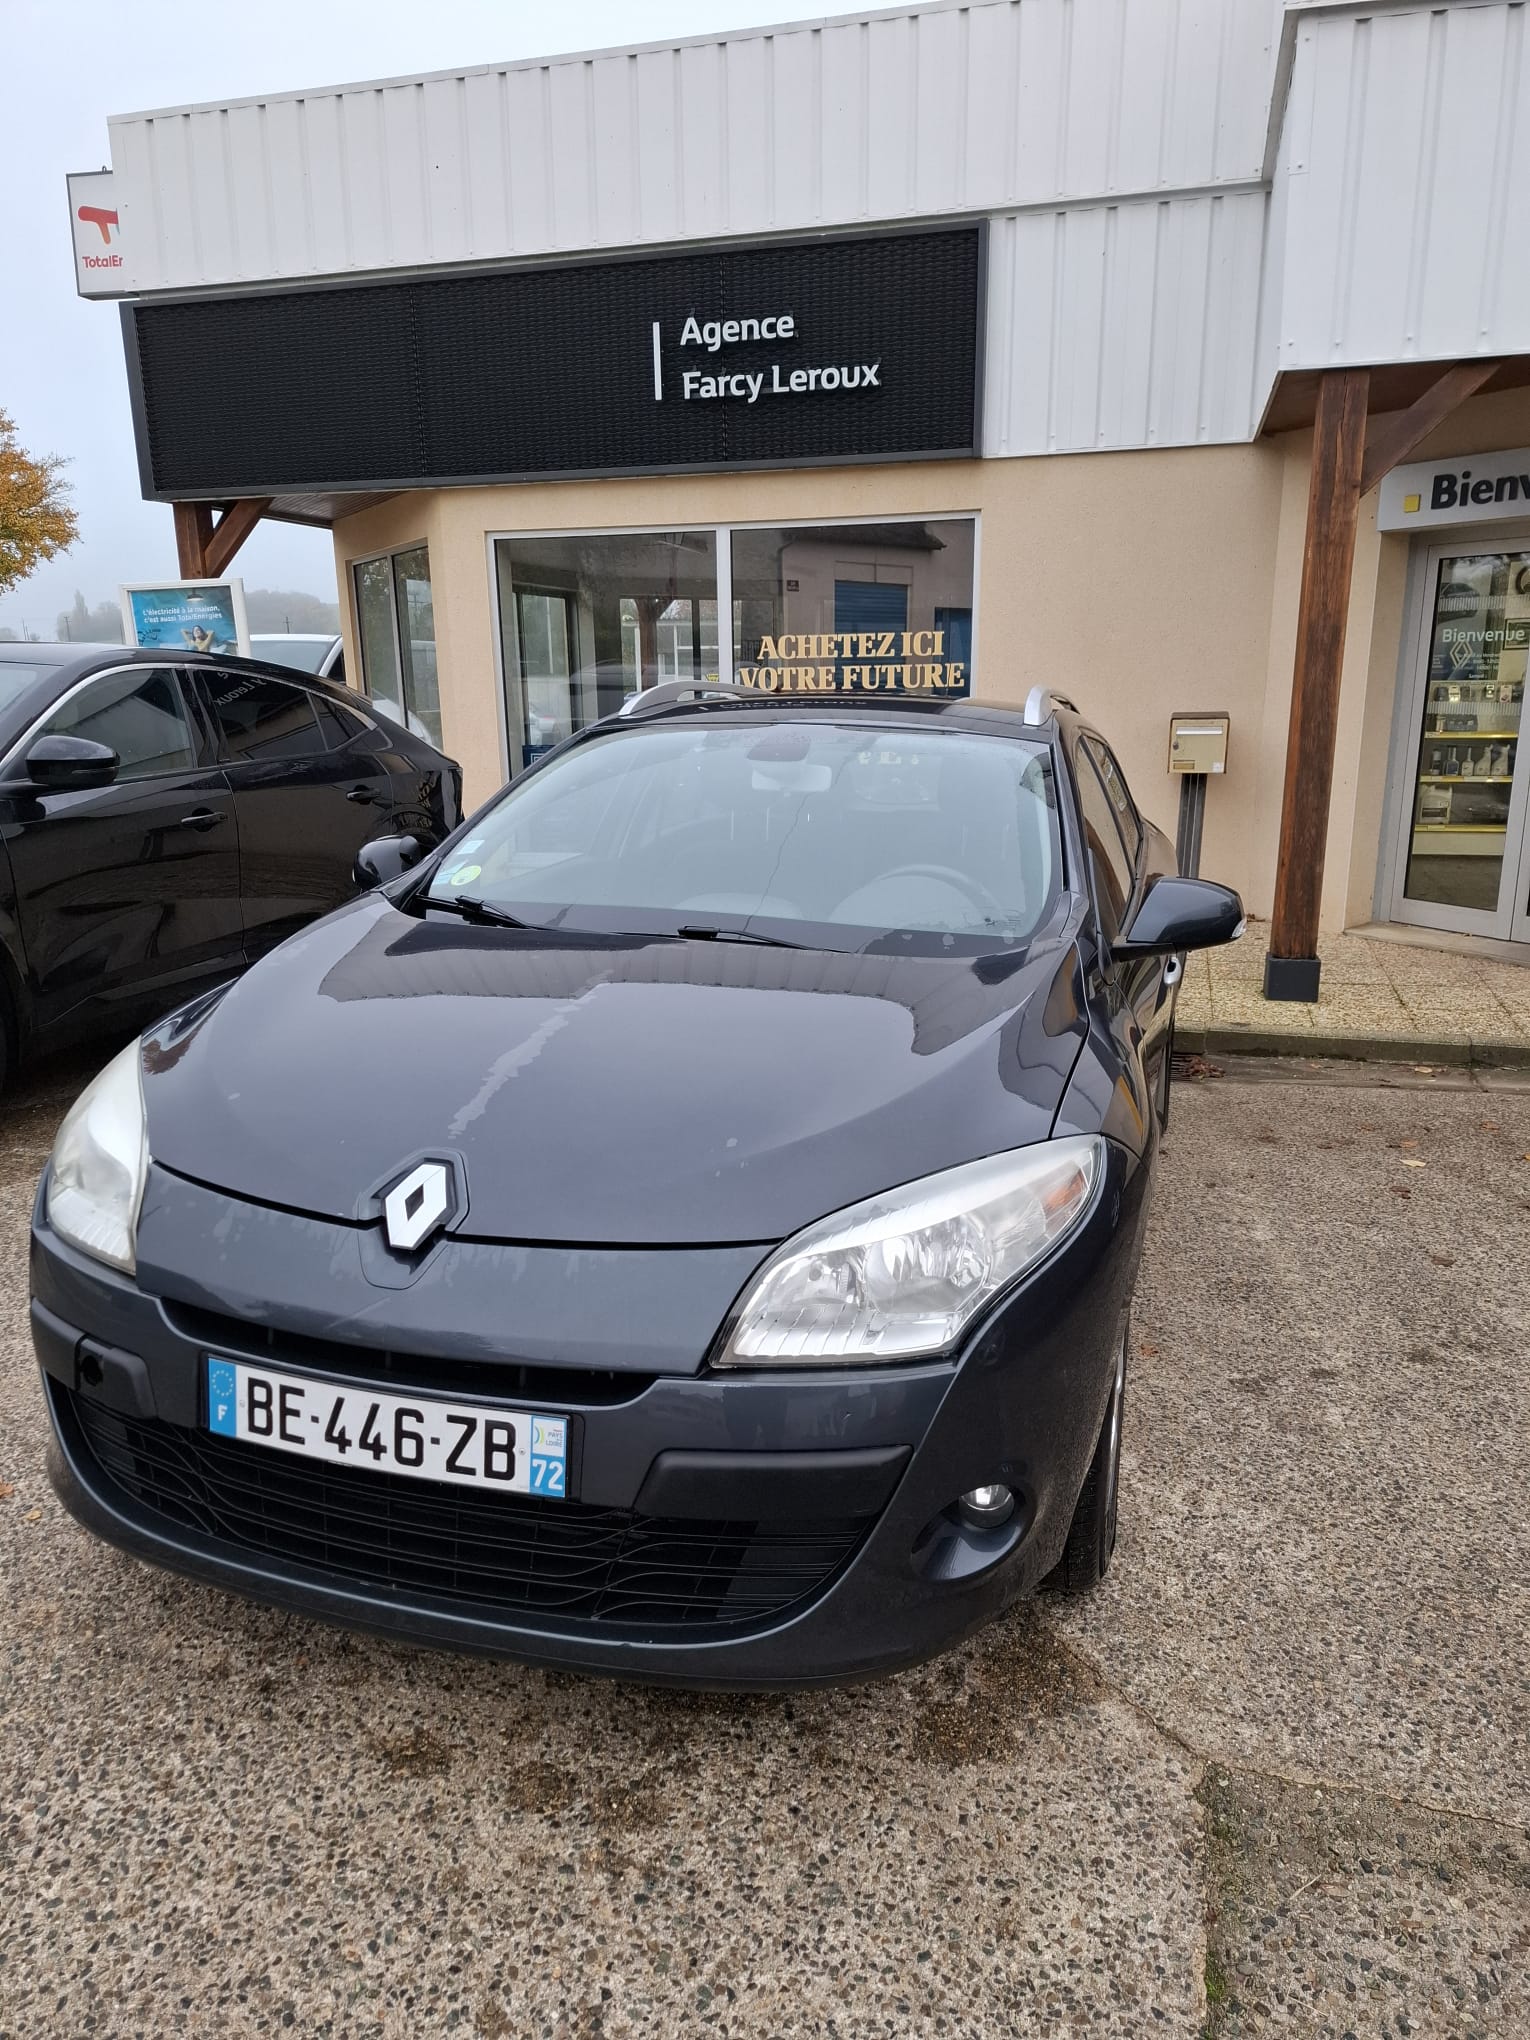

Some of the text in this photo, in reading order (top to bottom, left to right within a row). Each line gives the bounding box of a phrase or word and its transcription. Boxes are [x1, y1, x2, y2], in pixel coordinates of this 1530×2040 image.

[680, 316, 794, 352] Agence
[682, 363, 881, 404] Farcy Leroux
[757, 630, 945, 660] ACHETEZ ICI
[1442, 629, 1525, 642] Bienvenue
[740, 663, 966, 692] VOTRE FUTURE
[218, 1404, 228, 1421] F
[248, 1376, 516, 1481] BE-446-ZB
[532, 1459, 563, 1490] 72
